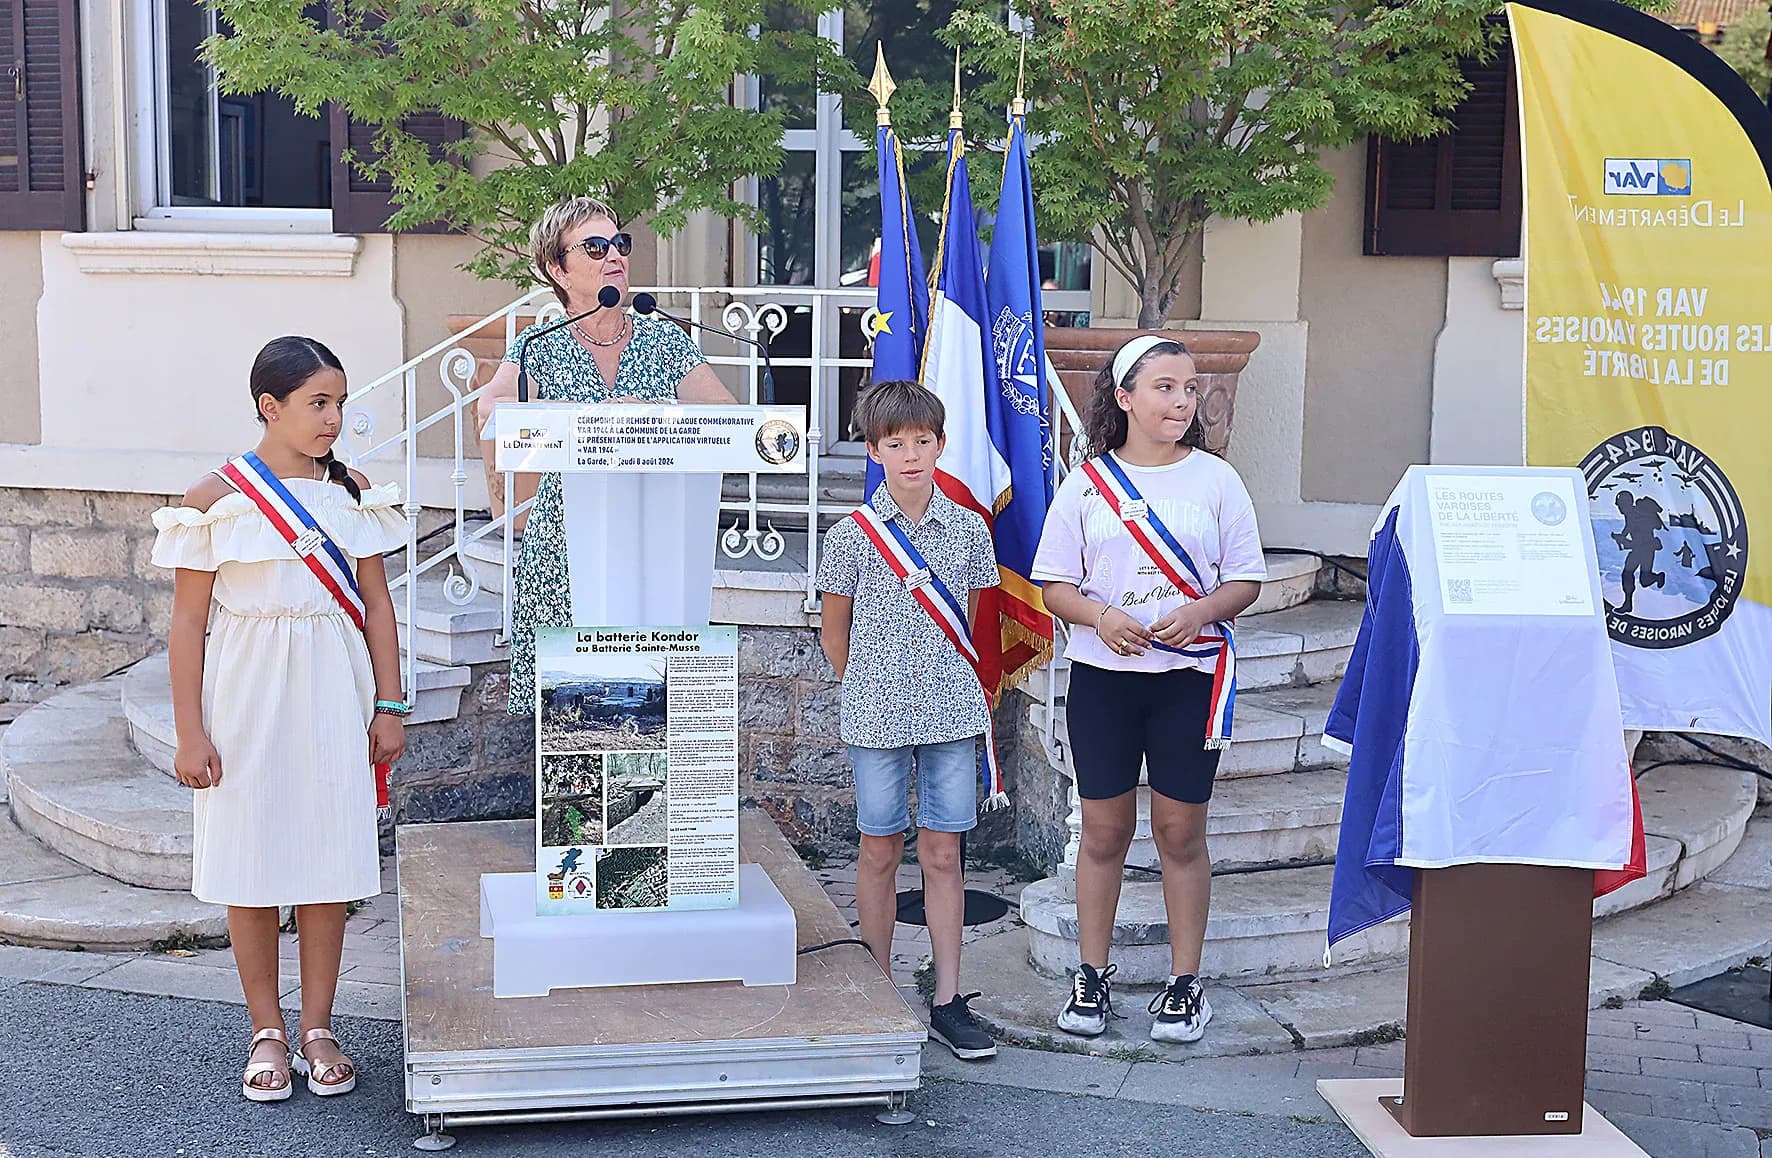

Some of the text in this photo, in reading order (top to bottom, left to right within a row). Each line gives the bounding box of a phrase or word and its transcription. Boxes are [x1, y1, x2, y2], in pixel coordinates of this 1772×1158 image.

[616, 416, 626, 425] DE
[672, 416, 698, 425] PLAQUE
[698, 416, 755, 426] COMMÉMORATIVE
[577, 426, 592, 434] VAR
[616, 426, 625, 434] LA
[625, 426, 658, 435] COMMUNE
[659, 426, 668, 435] DE
[669, 427, 678, 435] LA
[678, 427, 701, 435] GARDE
[577, 435, 731, 445] ET PRÉSENTATION DE L'APPLICATION VIRTUELLE
[583, 446, 597, 454] VAR
[598, 446, 614, 454] 1944
[577, 457, 586, 466] La
[587, 457, 610, 467] Garde,
[636, 457, 641, 466] 8
[658, 457, 675, 466] 2024
[1435, 491, 1505, 501] LES ROUTES
[1437, 502, 1492, 511] VAROISES
[1438, 511, 1454, 521] DE
[1456, 511, 1472, 521] LA
[1121, 591, 1150, 607] Best
[577, 630, 699, 643] La batterie Kondor
[575, 643, 701, 653] ou Batterie Sainte-Musse
